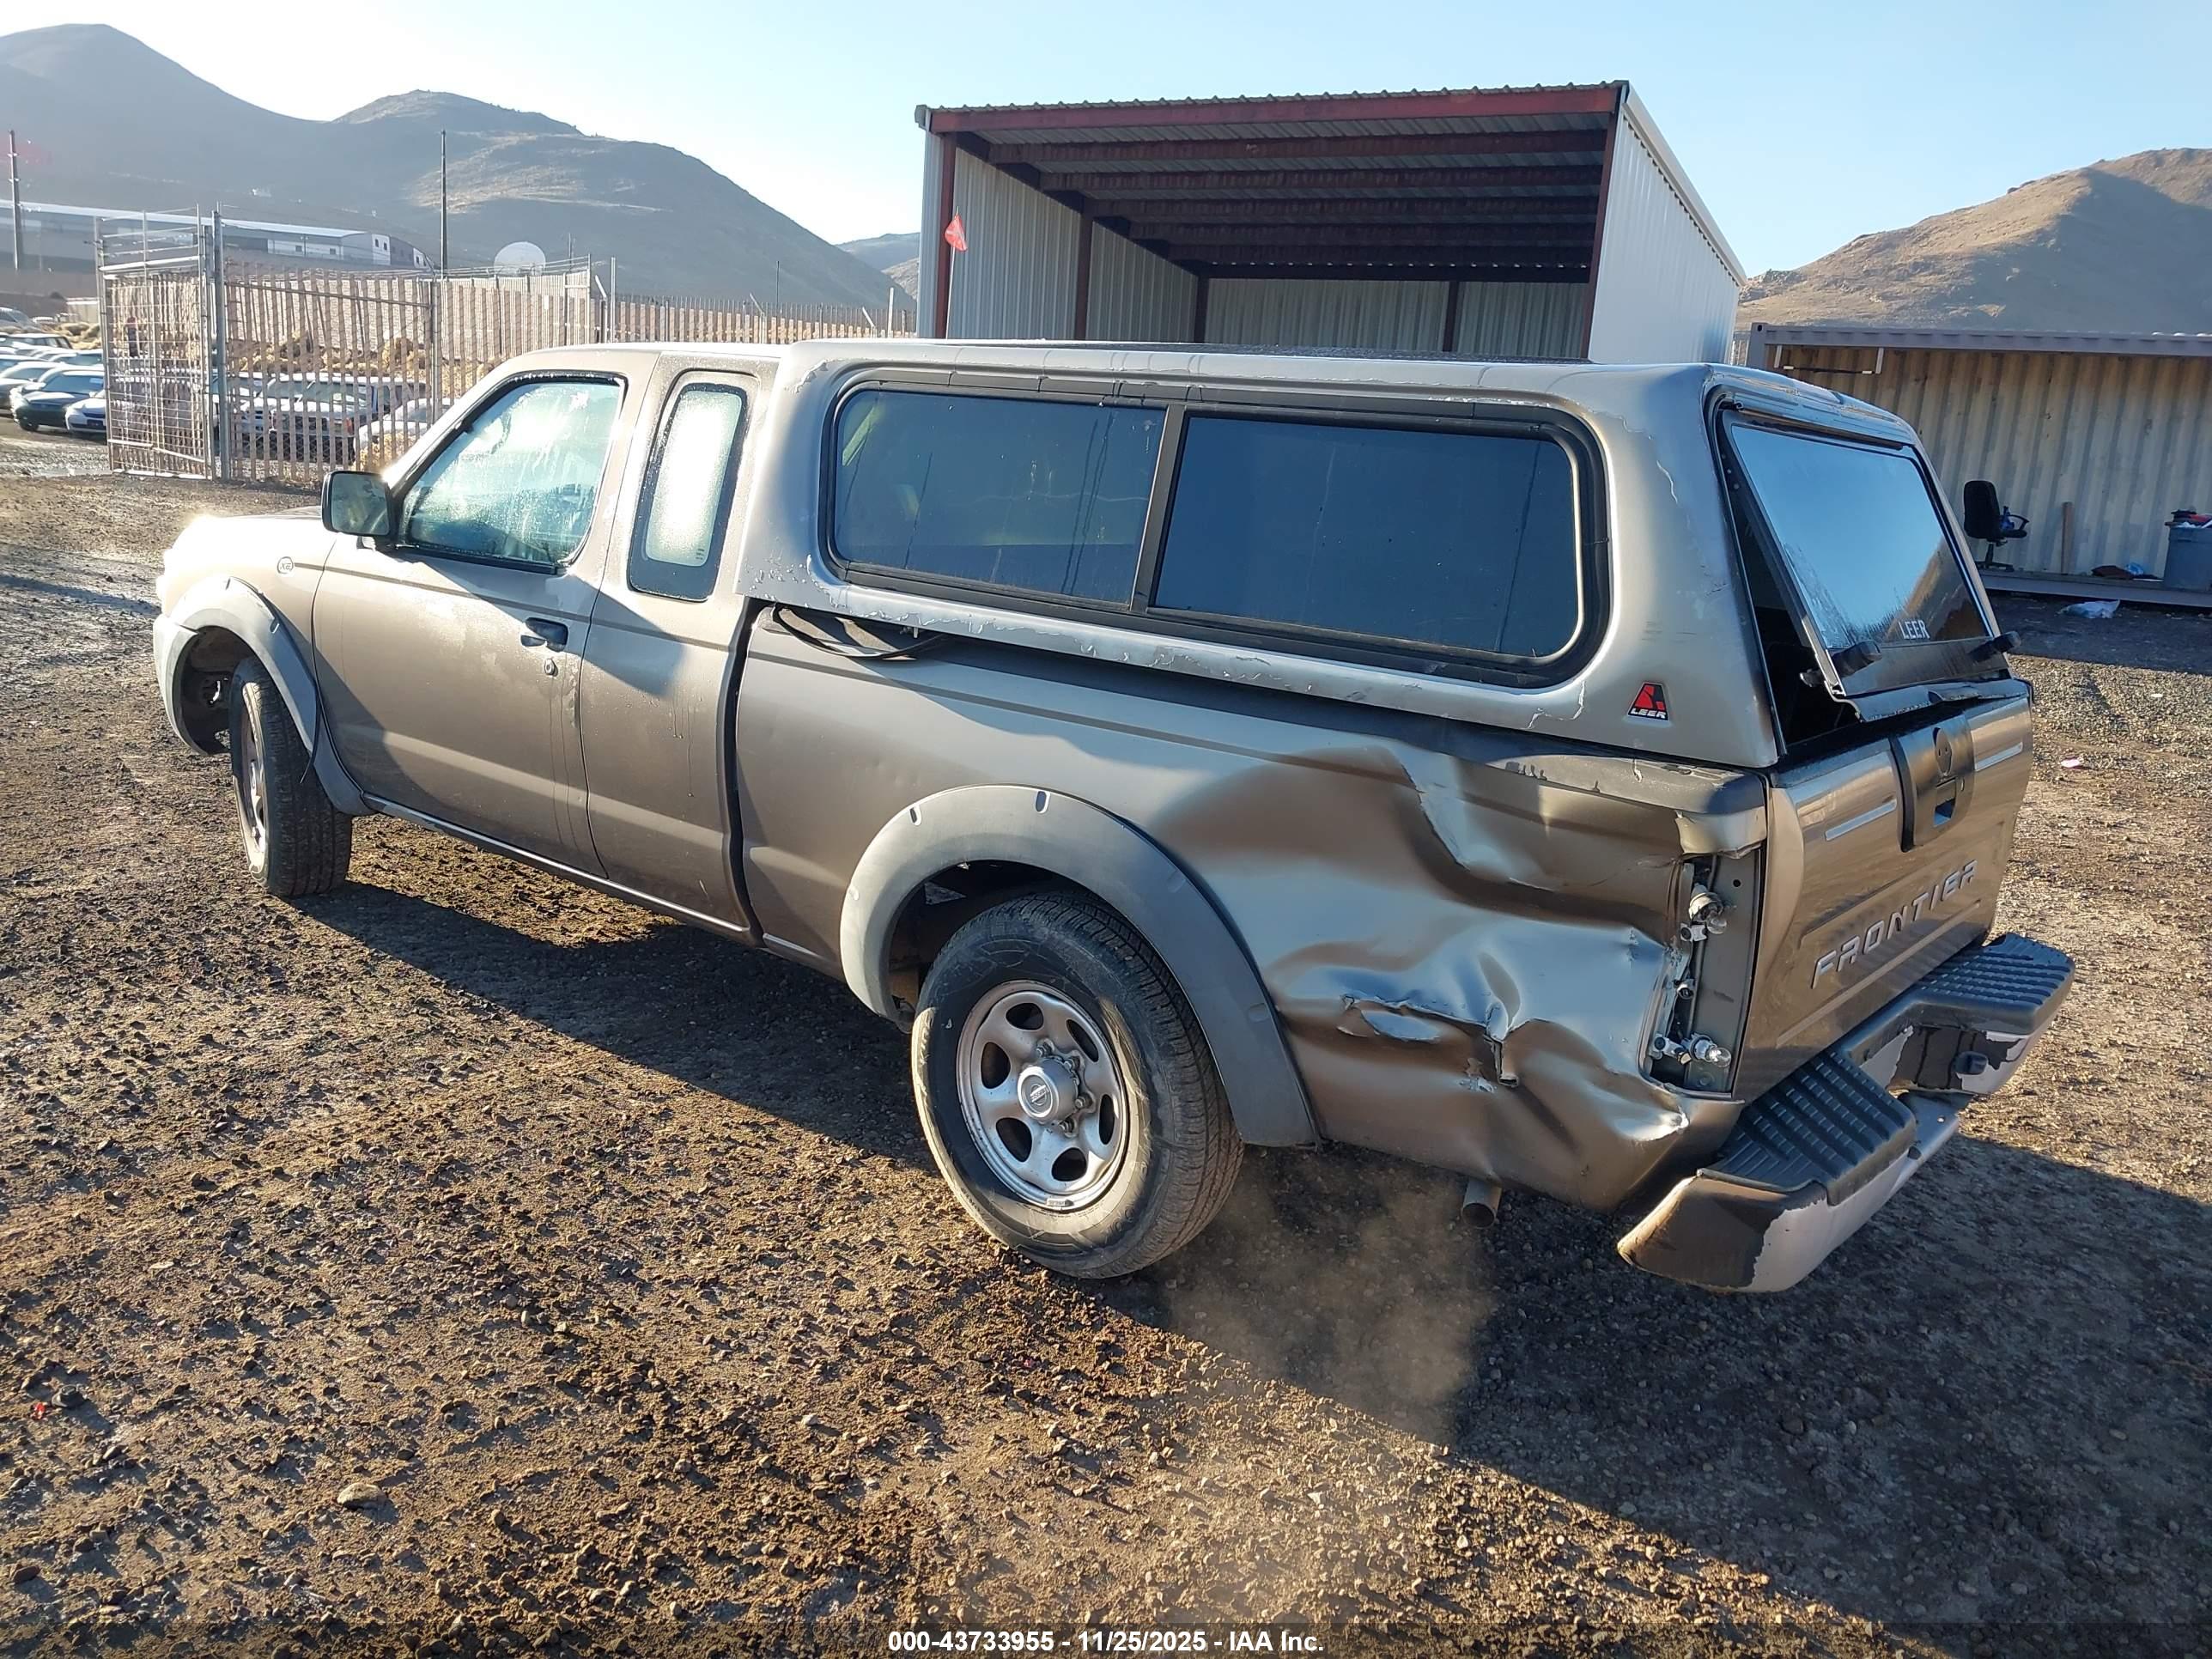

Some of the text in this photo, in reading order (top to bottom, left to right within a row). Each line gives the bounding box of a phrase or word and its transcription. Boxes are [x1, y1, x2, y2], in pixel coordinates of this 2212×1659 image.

[1898, 619, 1930, 640] LEER
[1630, 708, 1667, 719] LEER
[1811, 859, 1978, 989] FRONTIER
